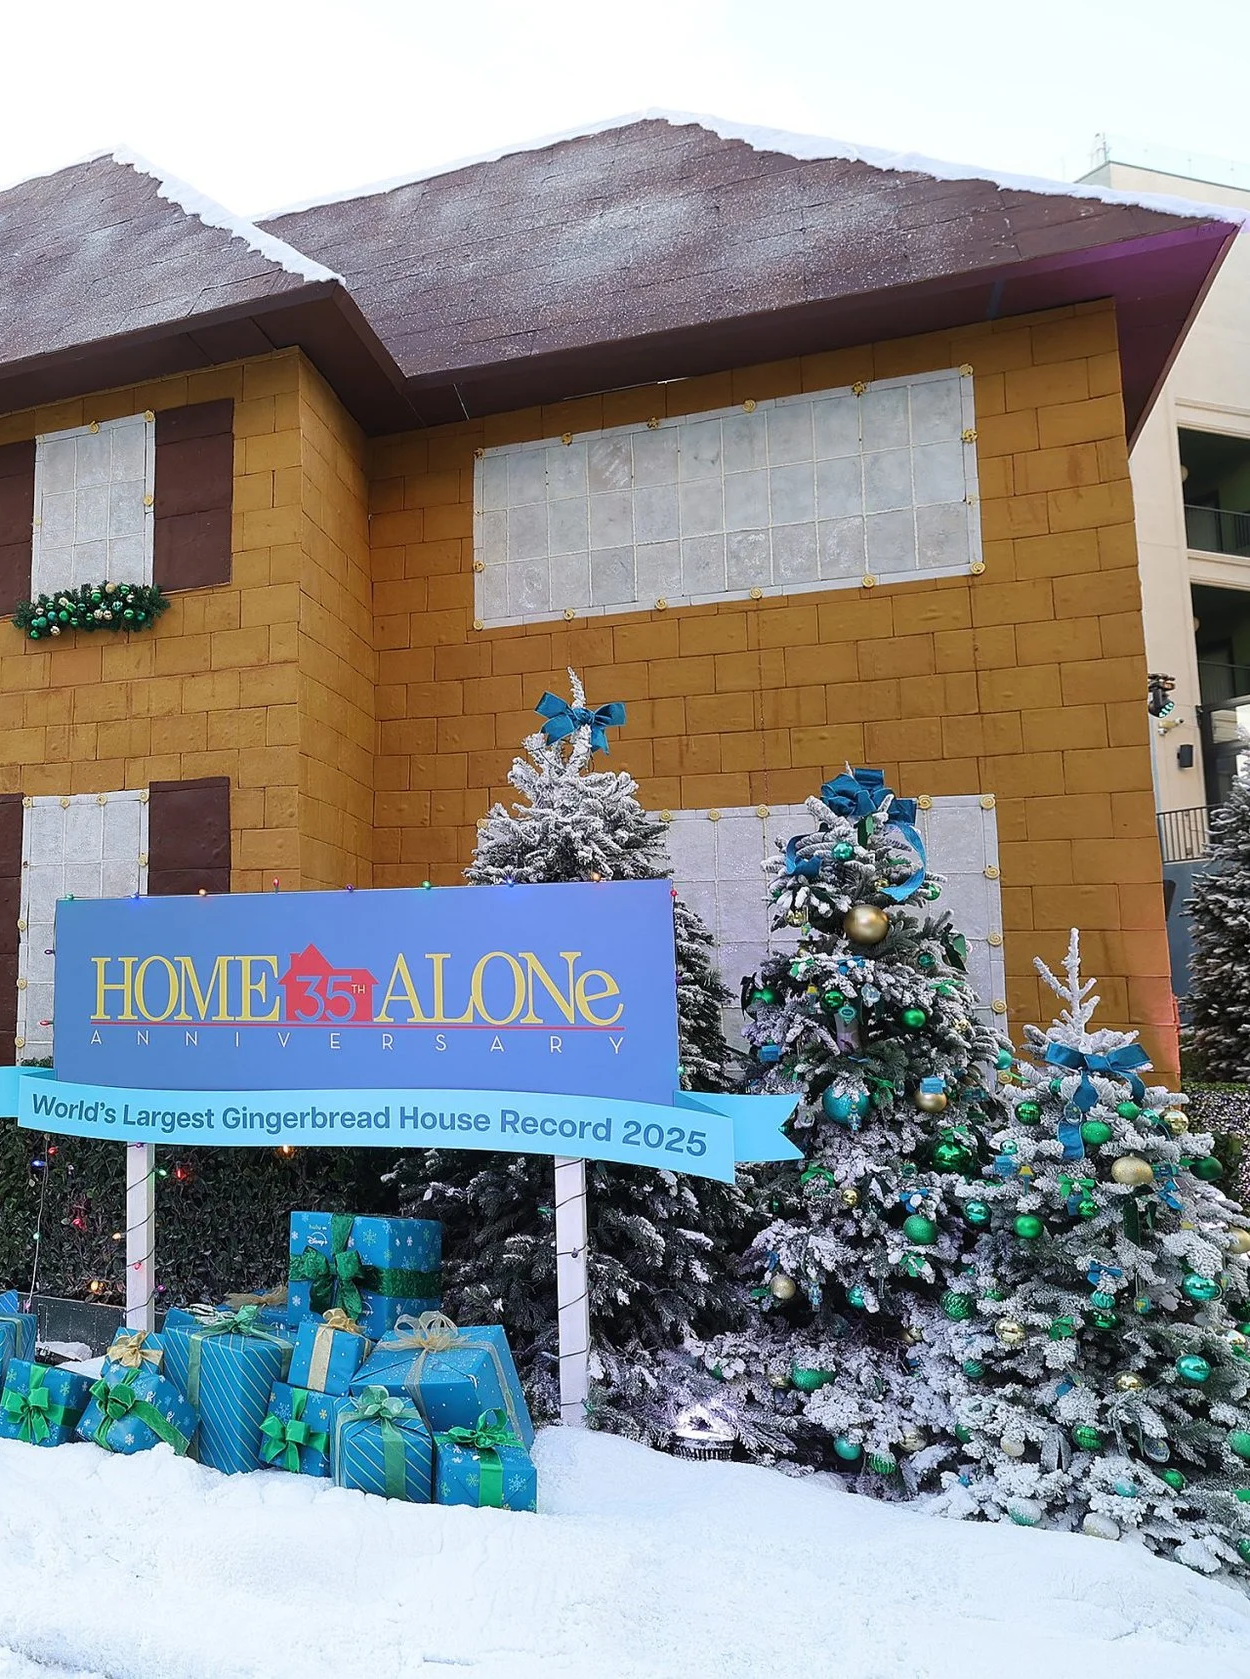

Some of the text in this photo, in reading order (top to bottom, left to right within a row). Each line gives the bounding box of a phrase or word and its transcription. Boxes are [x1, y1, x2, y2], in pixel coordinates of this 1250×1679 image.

[90, 954, 281, 1022] HOME
[90, 1029, 625, 1054] ANNIVERSARY
[31, 1093, 708, 1158] World's Largest Gingerbread House Record 2025
